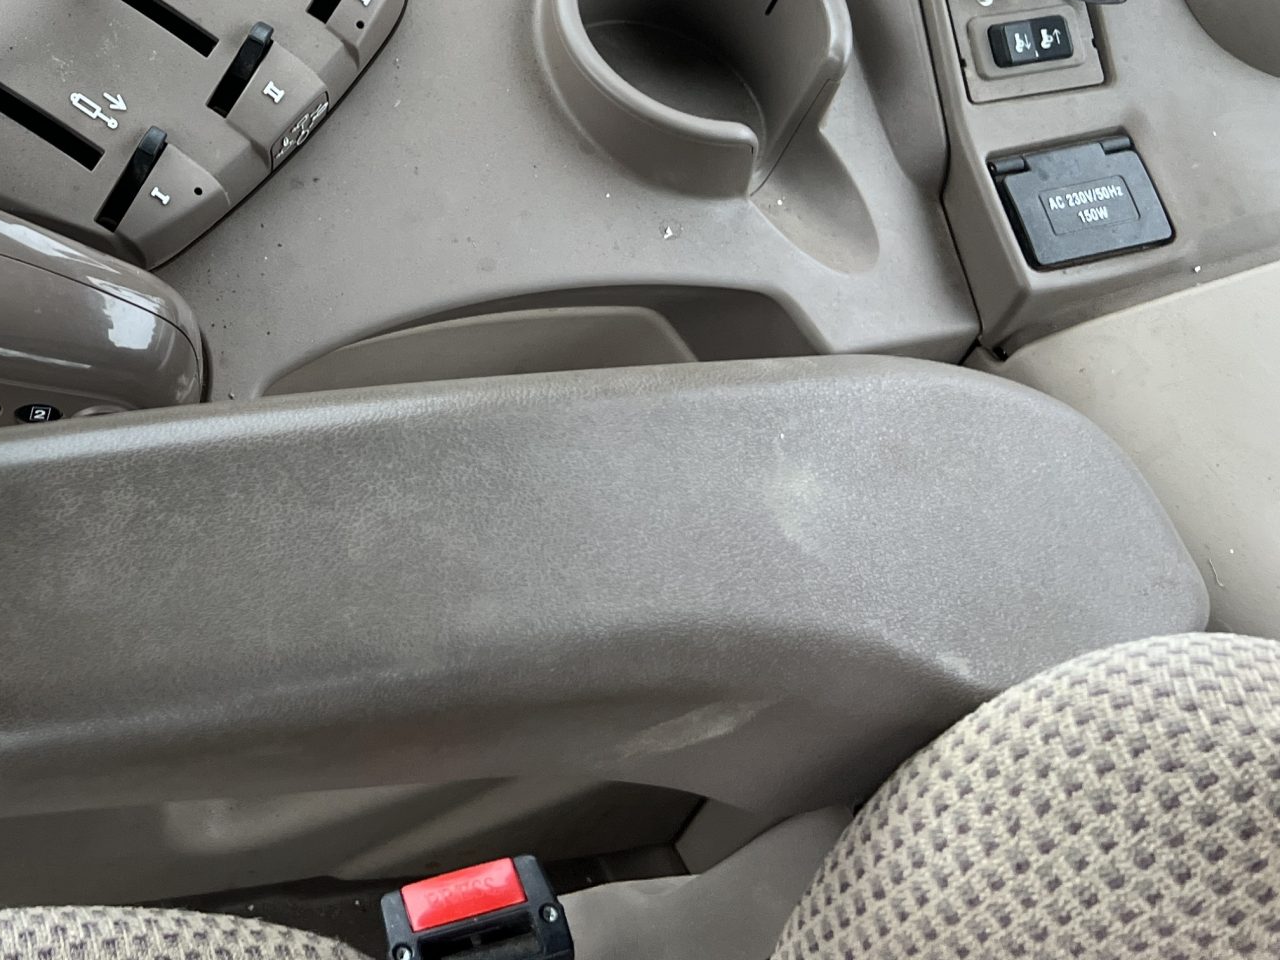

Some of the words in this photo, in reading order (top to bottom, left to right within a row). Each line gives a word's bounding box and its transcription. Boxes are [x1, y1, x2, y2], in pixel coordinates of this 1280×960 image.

[262, 80, 285, 104] II
[150, 186, 170, 205] I
[1048, 195, 1066, 211] AC
[1065, 184, 1124, 208] 230V/50Hz
[1077, 205, 1109, 223] 150W
[33, 409, 46, 420] 2
